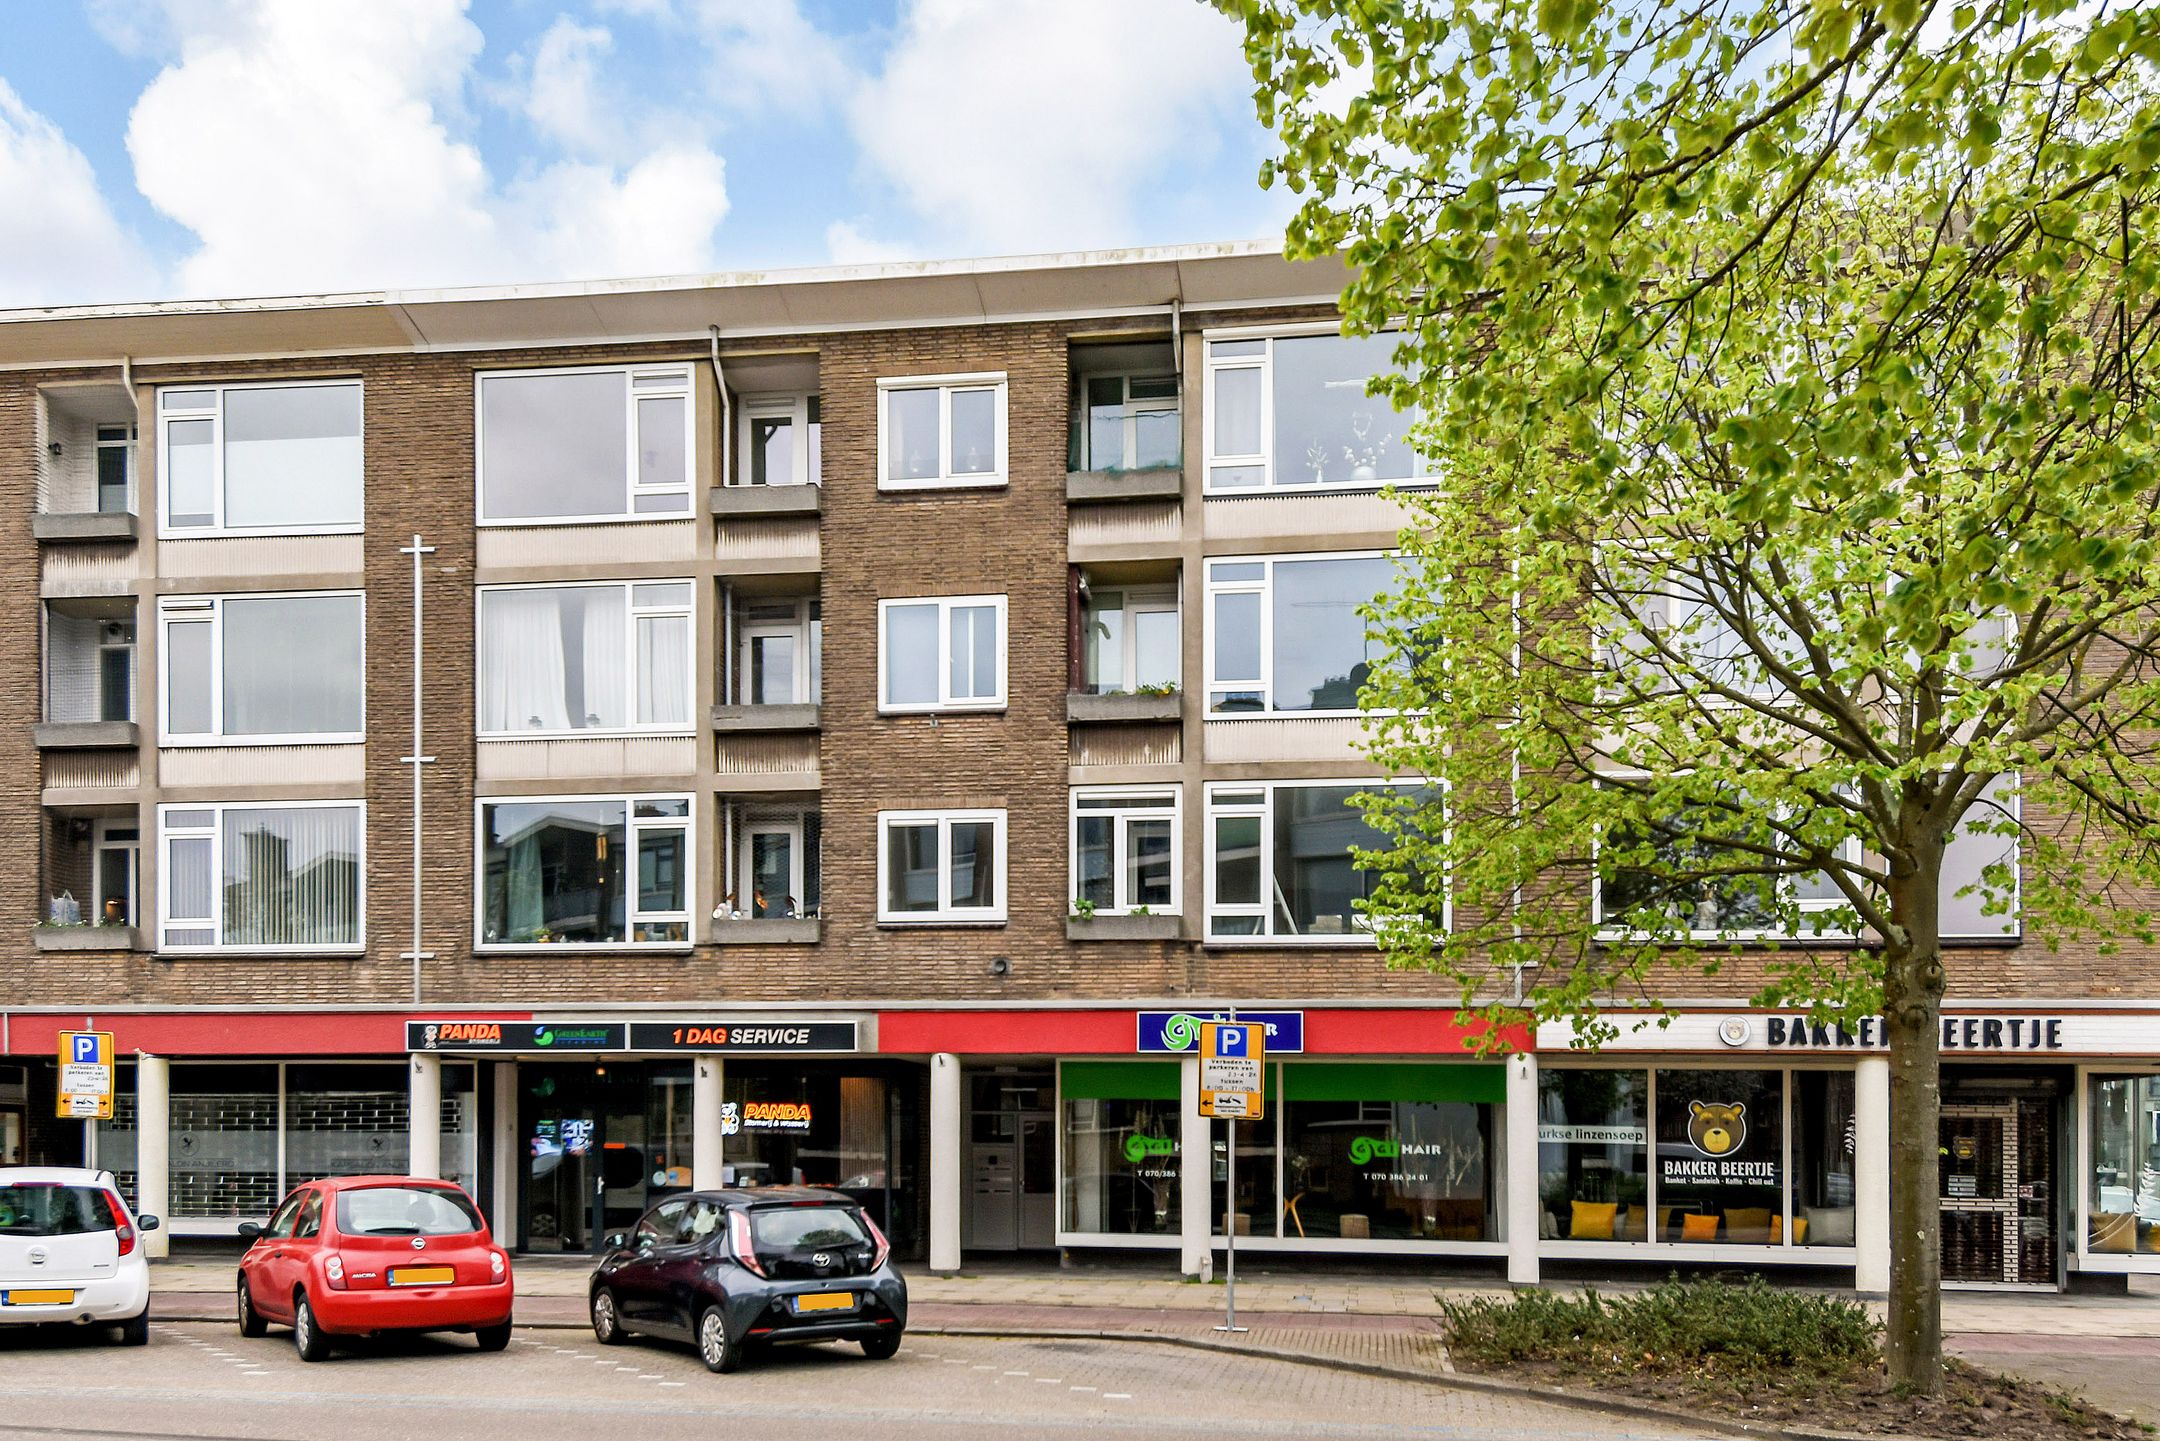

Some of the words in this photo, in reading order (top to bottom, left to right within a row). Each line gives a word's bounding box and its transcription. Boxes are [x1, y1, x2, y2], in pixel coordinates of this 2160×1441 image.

[440, 1024, 501, 1039] PANDA
[673, 1029, 682, 1044] 1
[686, 1028, 727, 1044] DAG
[730, 1029, 810, 1044] SERVICE
[1943, 1019, 2063, 1048] EERTJE
[77, 1038, 93, 1061] P
[1222, 1029, 1241, 1054] P
[743, 1103, 811, 1120] PANDA
[1538, 1128, 1572, 1140] urkse
[1576, 1129, 1643, 1142] linzensoep
[1402, 1144, 1441, 1155] HAIR
[1664, 1160, 1717, 1176] BAKKER
[1721, 1161, 1774, 1176] BEERTJE
[1371, 1173, 1387, 1181] 070
